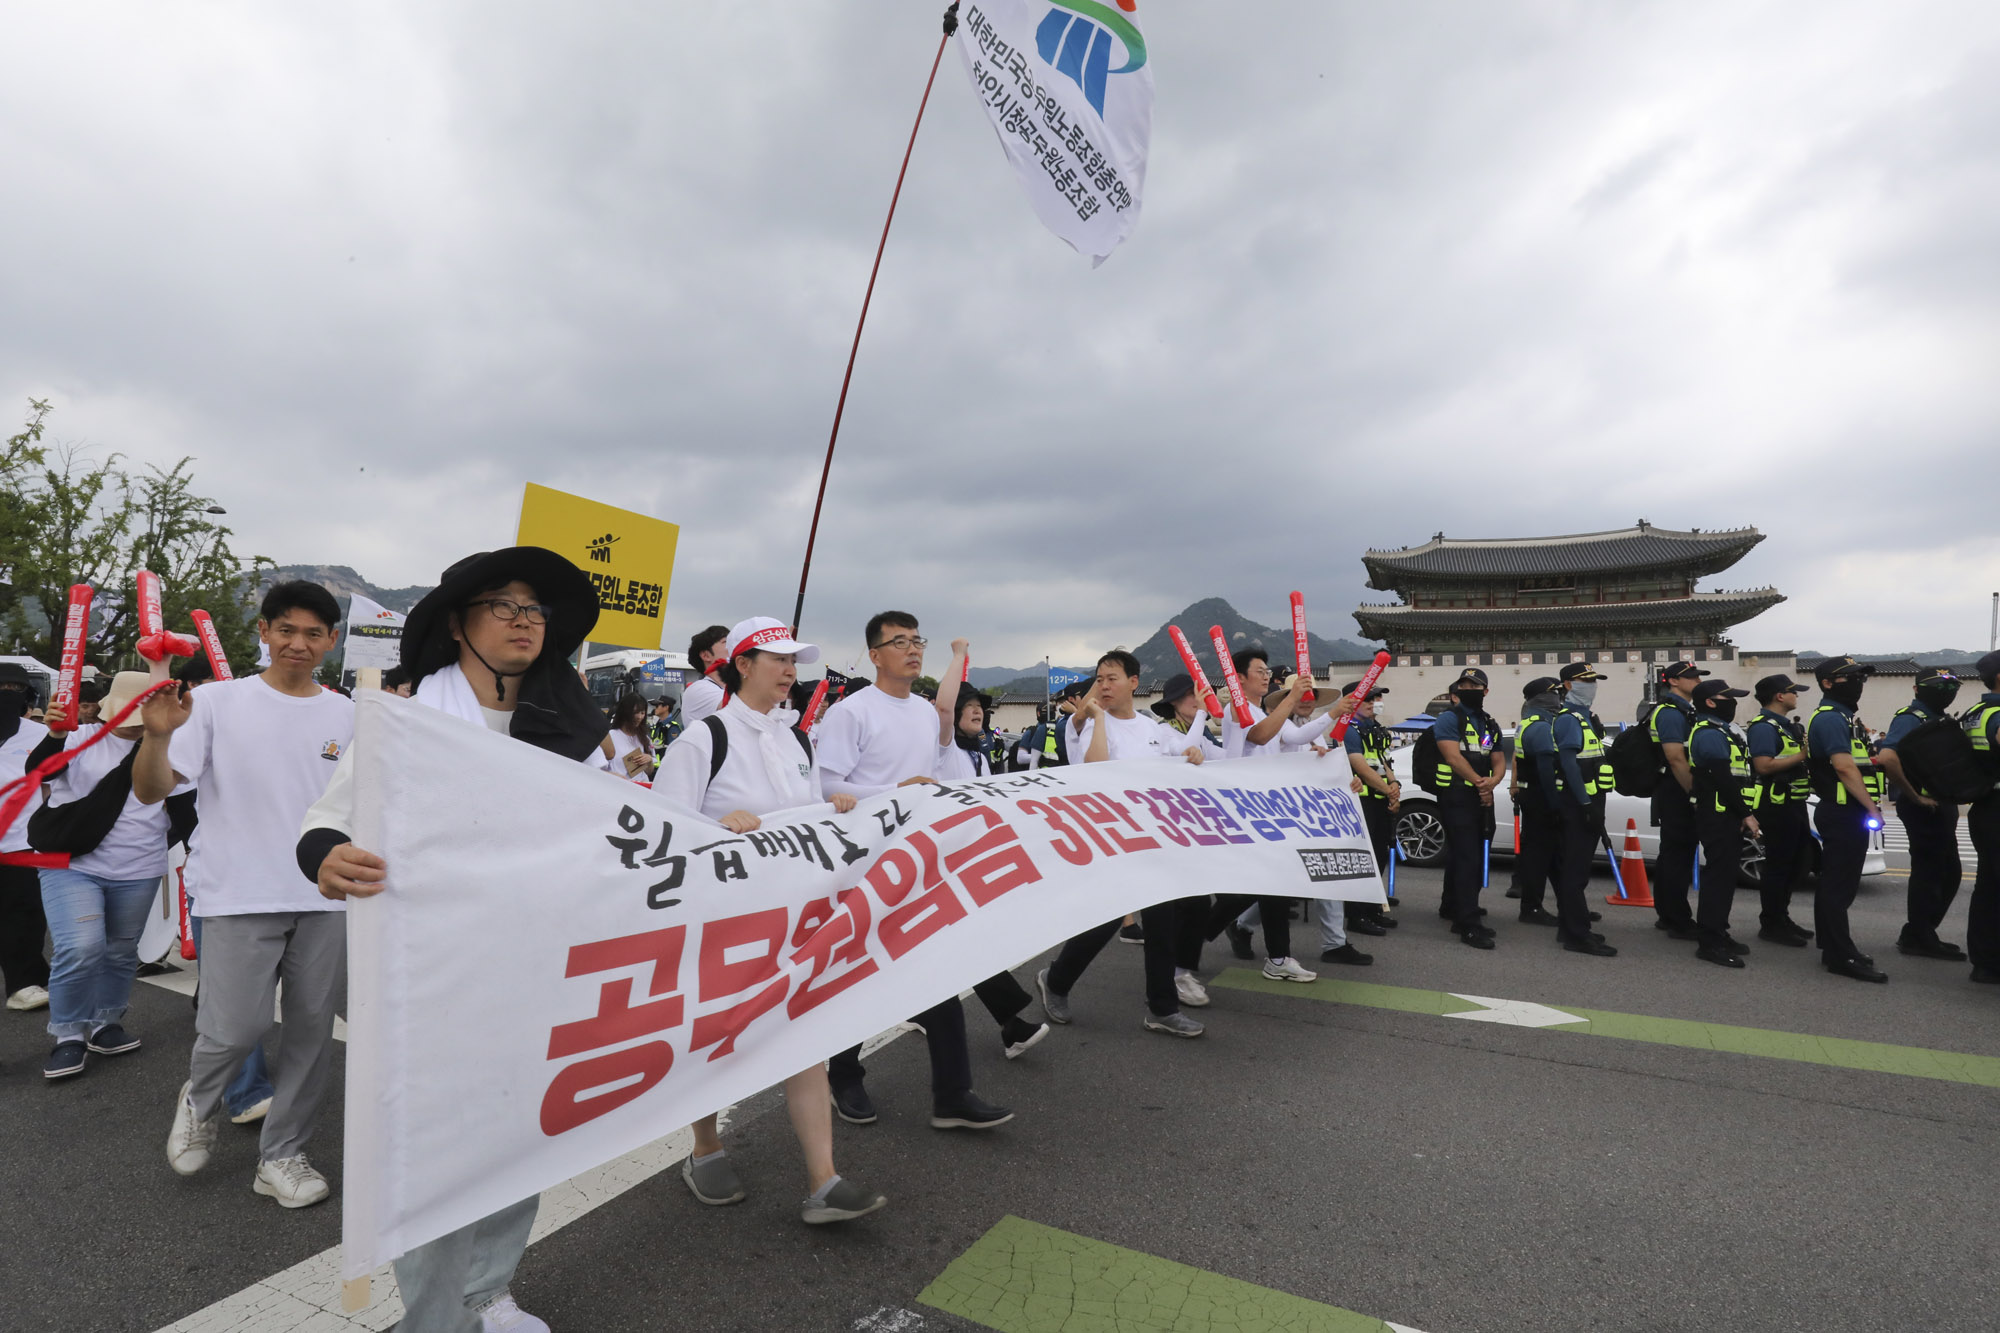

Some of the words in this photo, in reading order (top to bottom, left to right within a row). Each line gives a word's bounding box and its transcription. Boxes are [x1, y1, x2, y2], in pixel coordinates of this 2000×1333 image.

[581, 569, 663, 618] 무원노동조합
[63, 603, 86, 650] 월급빼고
[1297, 642, 1308, 652] 다
[61, 654, 78, 666] 다
[1050, 675, 1079, 684] 12기-2
[57, 669, 76, 705] 올랐다
[1016, 791, 1162, 866] 31만
[1123, 788, 1254, 847] 3천원
[605, 804, 869, 910] 월급빼고
[872, 799, 912, 837] 다
